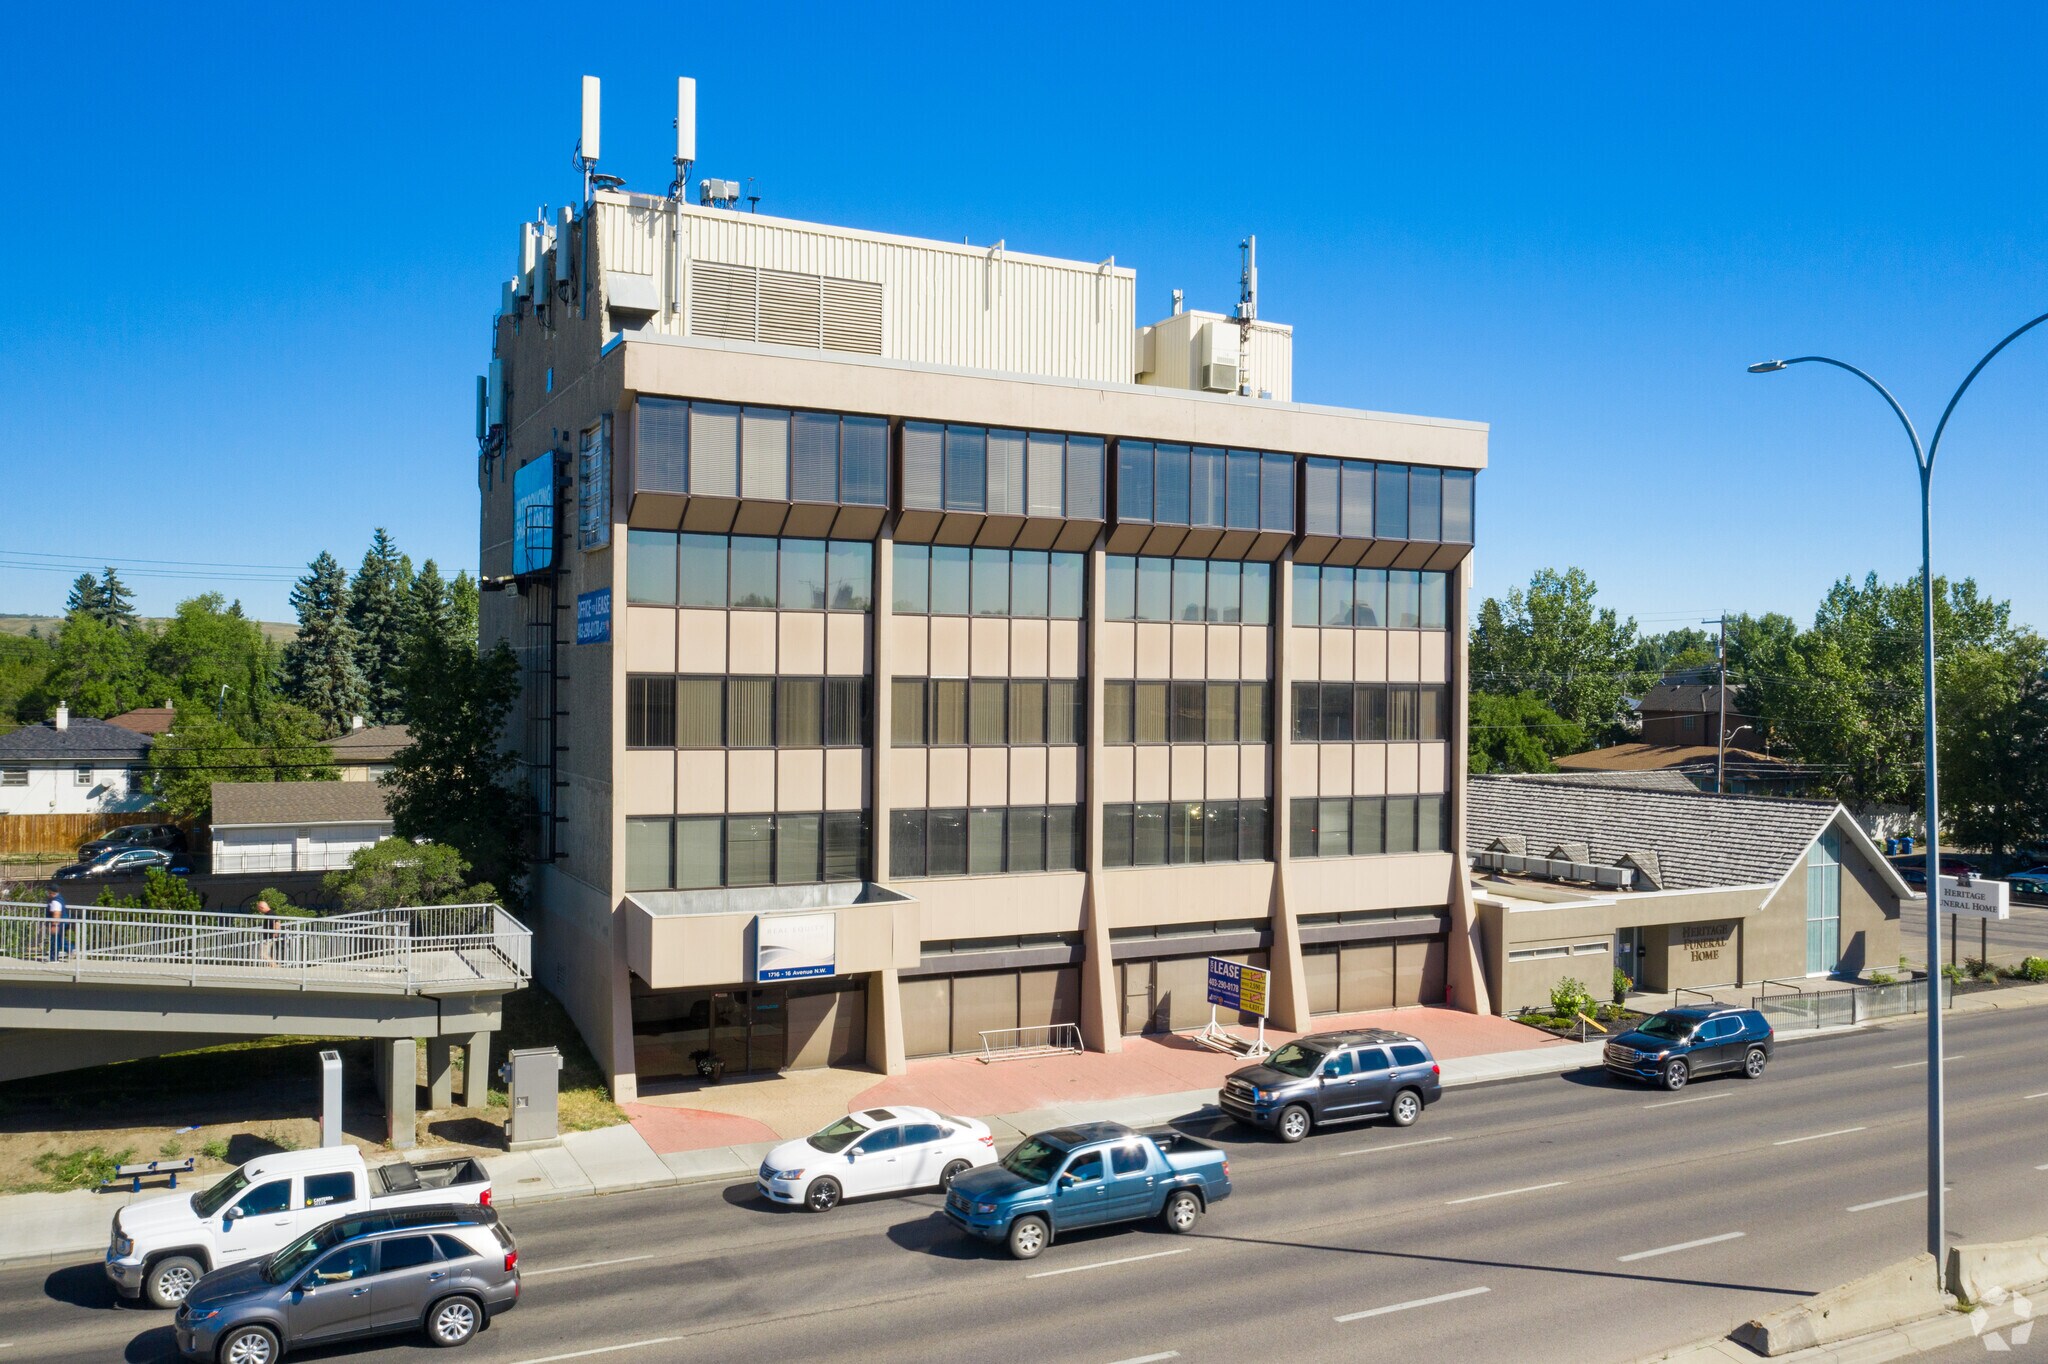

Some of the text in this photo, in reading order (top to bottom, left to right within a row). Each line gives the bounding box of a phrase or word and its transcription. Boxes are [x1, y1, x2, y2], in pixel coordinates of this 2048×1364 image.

[577, 599, 591, 619] OFFICE
[595, 594, 610, 615] LEASE
[1944, 888, 1986, 901] HERITAGE
[1939, 900, 1998, 913] UNERAL HOME
[1682, 925, 1728, 938] HERITAGE
[1683, 937, 1727, 951] FUNERAL
[1690, 950, 1719, 962] HOME
[792, 968, 813, 976] Avenue
[1214, 960, 1240, 979] LEASE
